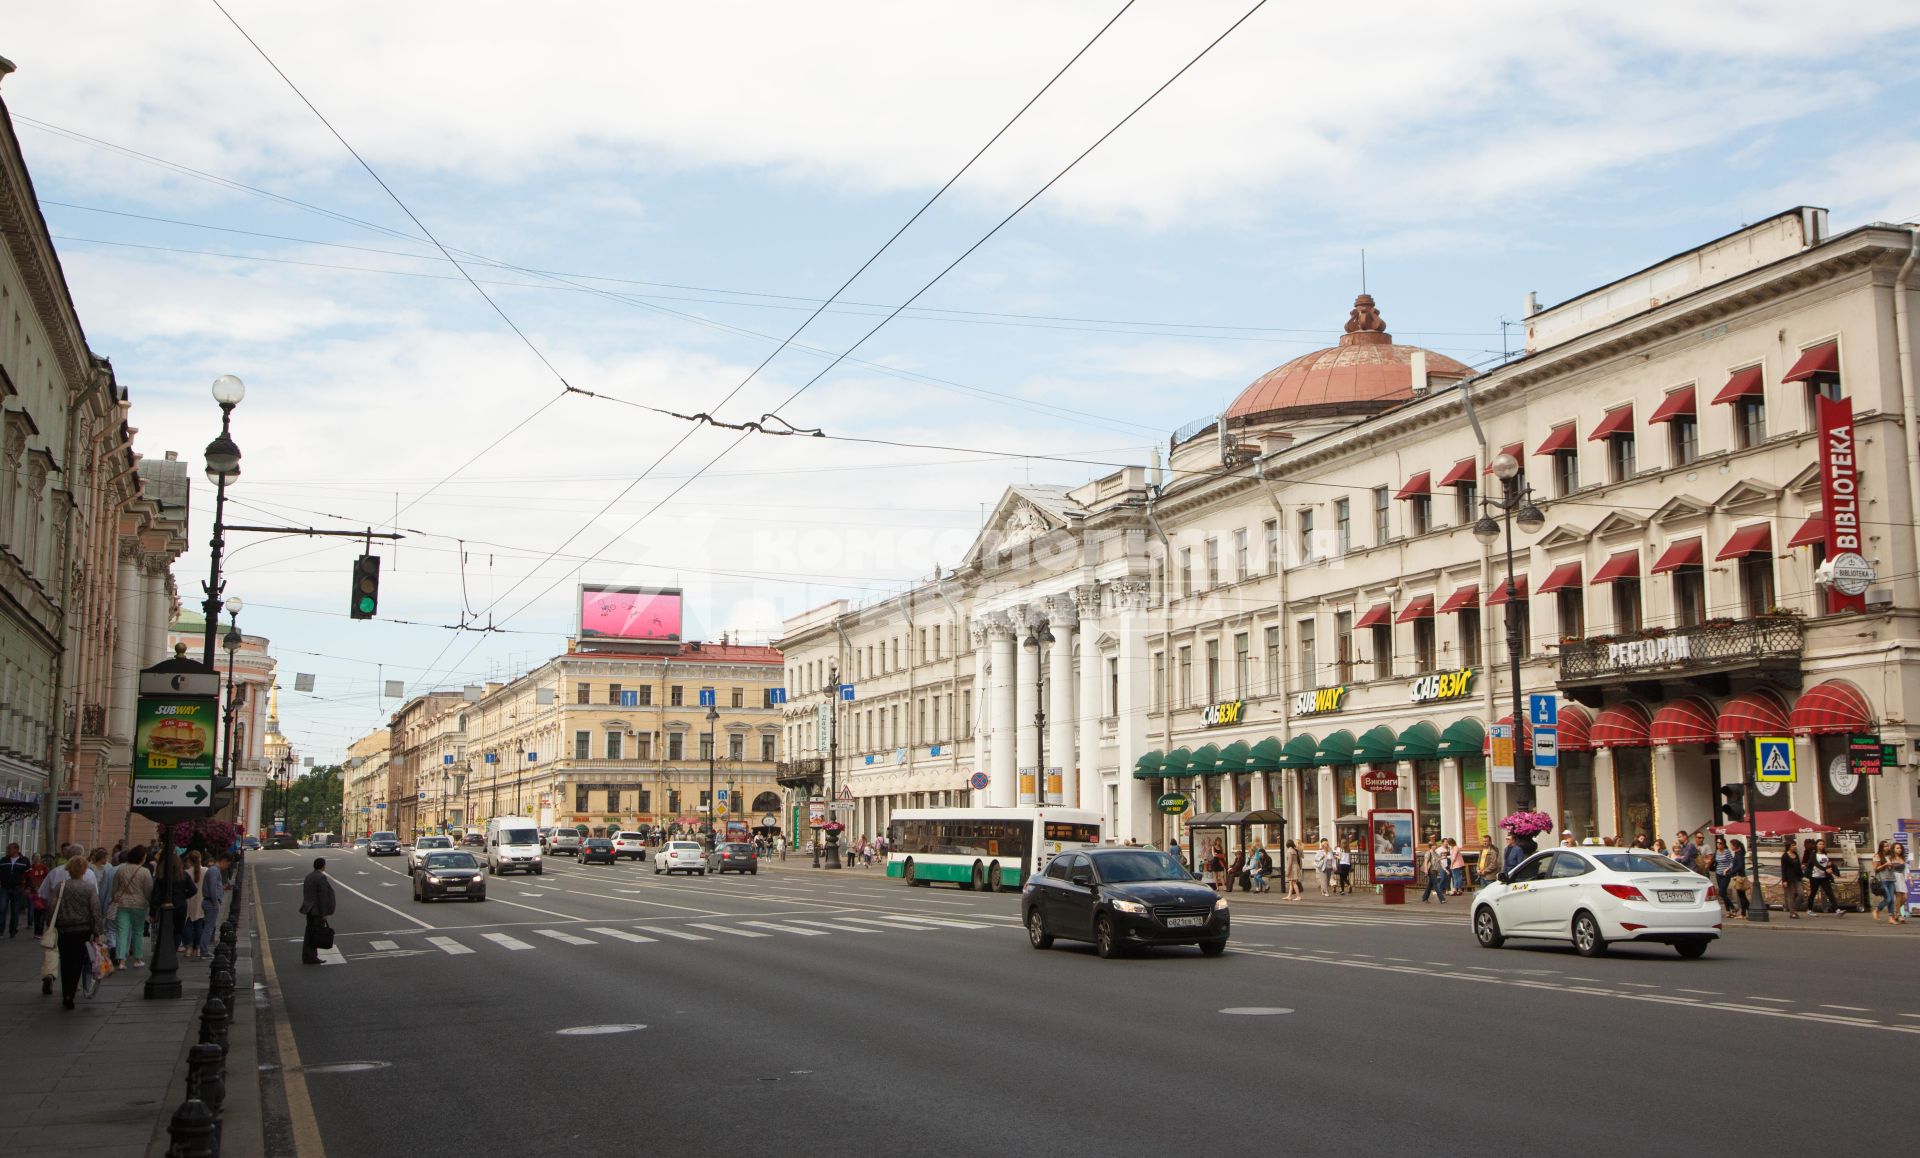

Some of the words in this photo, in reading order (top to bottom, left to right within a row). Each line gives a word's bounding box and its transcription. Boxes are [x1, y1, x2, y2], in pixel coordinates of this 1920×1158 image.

[1829, 425, 1858, 549] BIBLIOTEKA
[1839, 569, 1869, 578] BIBLIOTEKA
[1608, 636, 1691, 668] РЕСТОРАН
[1410, 668, 1472, 703] САБВЭЙ
[1295, 687, 1344, 715] SUBWAY
[155, 706, 200, 715] SUBWAY
[1200, 701, 1241, 727] САБВЭЙ
[152, 759, 168, 767] 119
[1365, 778, 1398, 786] Викинги
[136, 797, 148, 805] 60
